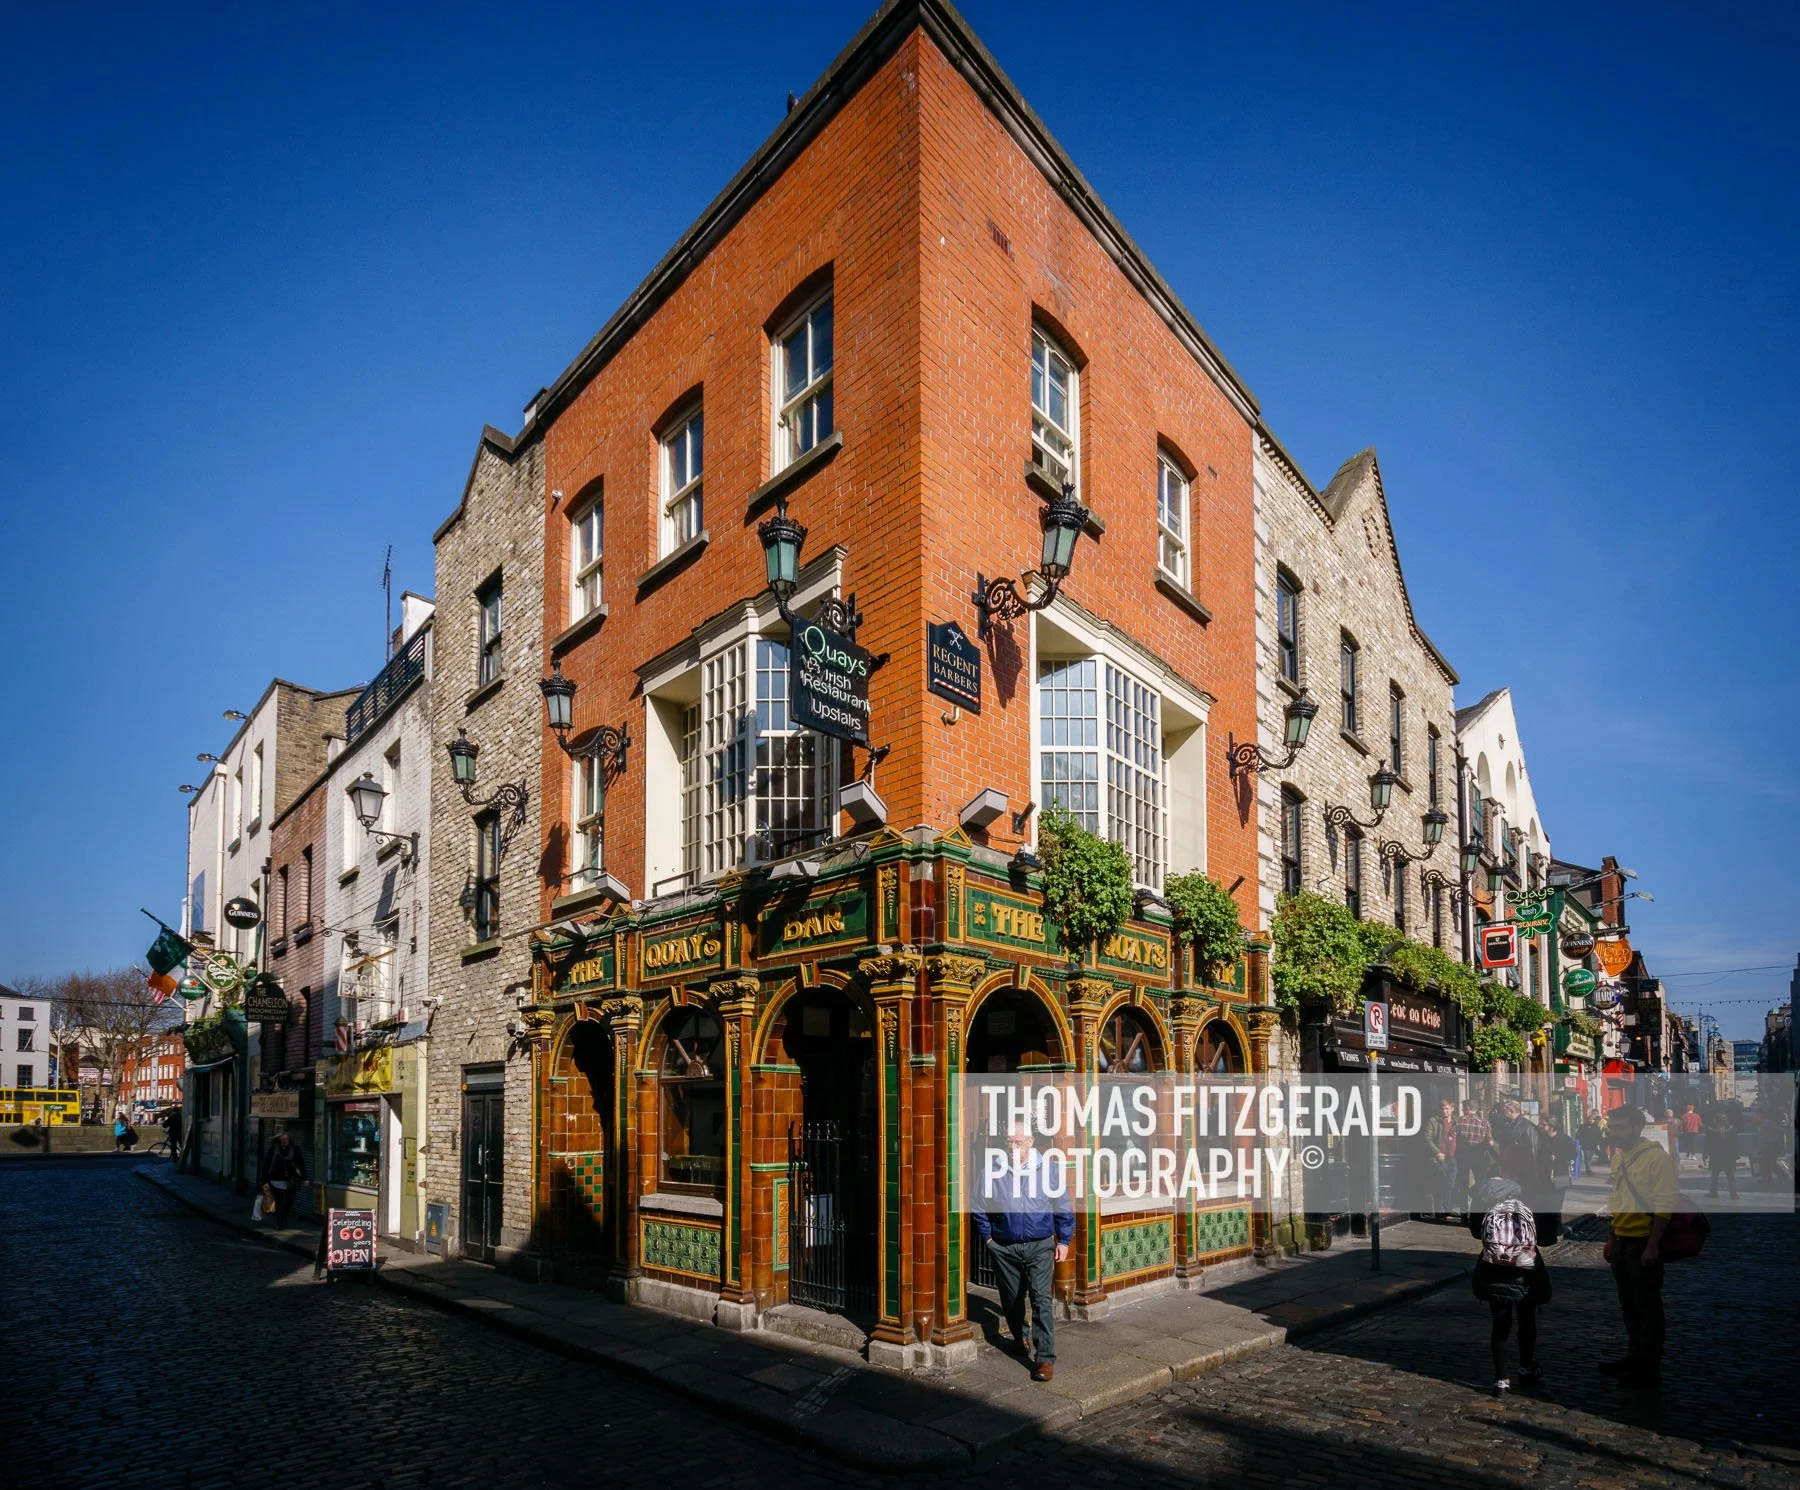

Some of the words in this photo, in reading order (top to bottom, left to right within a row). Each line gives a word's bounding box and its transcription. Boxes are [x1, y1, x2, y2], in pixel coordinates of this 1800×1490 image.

[804, 626, 867, 676] Quays
[933, 644, 978, 678] REGENT
[825, 669, 851, 690] Irish
[934, 662, 978, 693] BARBERS
[803, 673, 870, 714] Restaurant
[812, 698, 861, 730] Upstairs
[1505, 887, 1555, 904] Quays
[228, 909, 258, 919] GUINNESS
[783, 904, 845, 941] BAR
[991, 902, 1046, 942] THE
[646, 931, 721, 968] QUAYS
[1563, 939, 1592, 947] GUINNESS
[1604, 947, 1629, 957] OLD
[569, 956, 604, 985] THE
[248, 996, 288, 1009] CHAMELEON
[1595, 991, 1615, 1002] HARP
[333, 1219, 372, 1230] Celebrating
[340, 1227, 365, 1240] 60
[353, 1240, 371, 1248] years
[332, 1249, 369, 1264] OPEN
